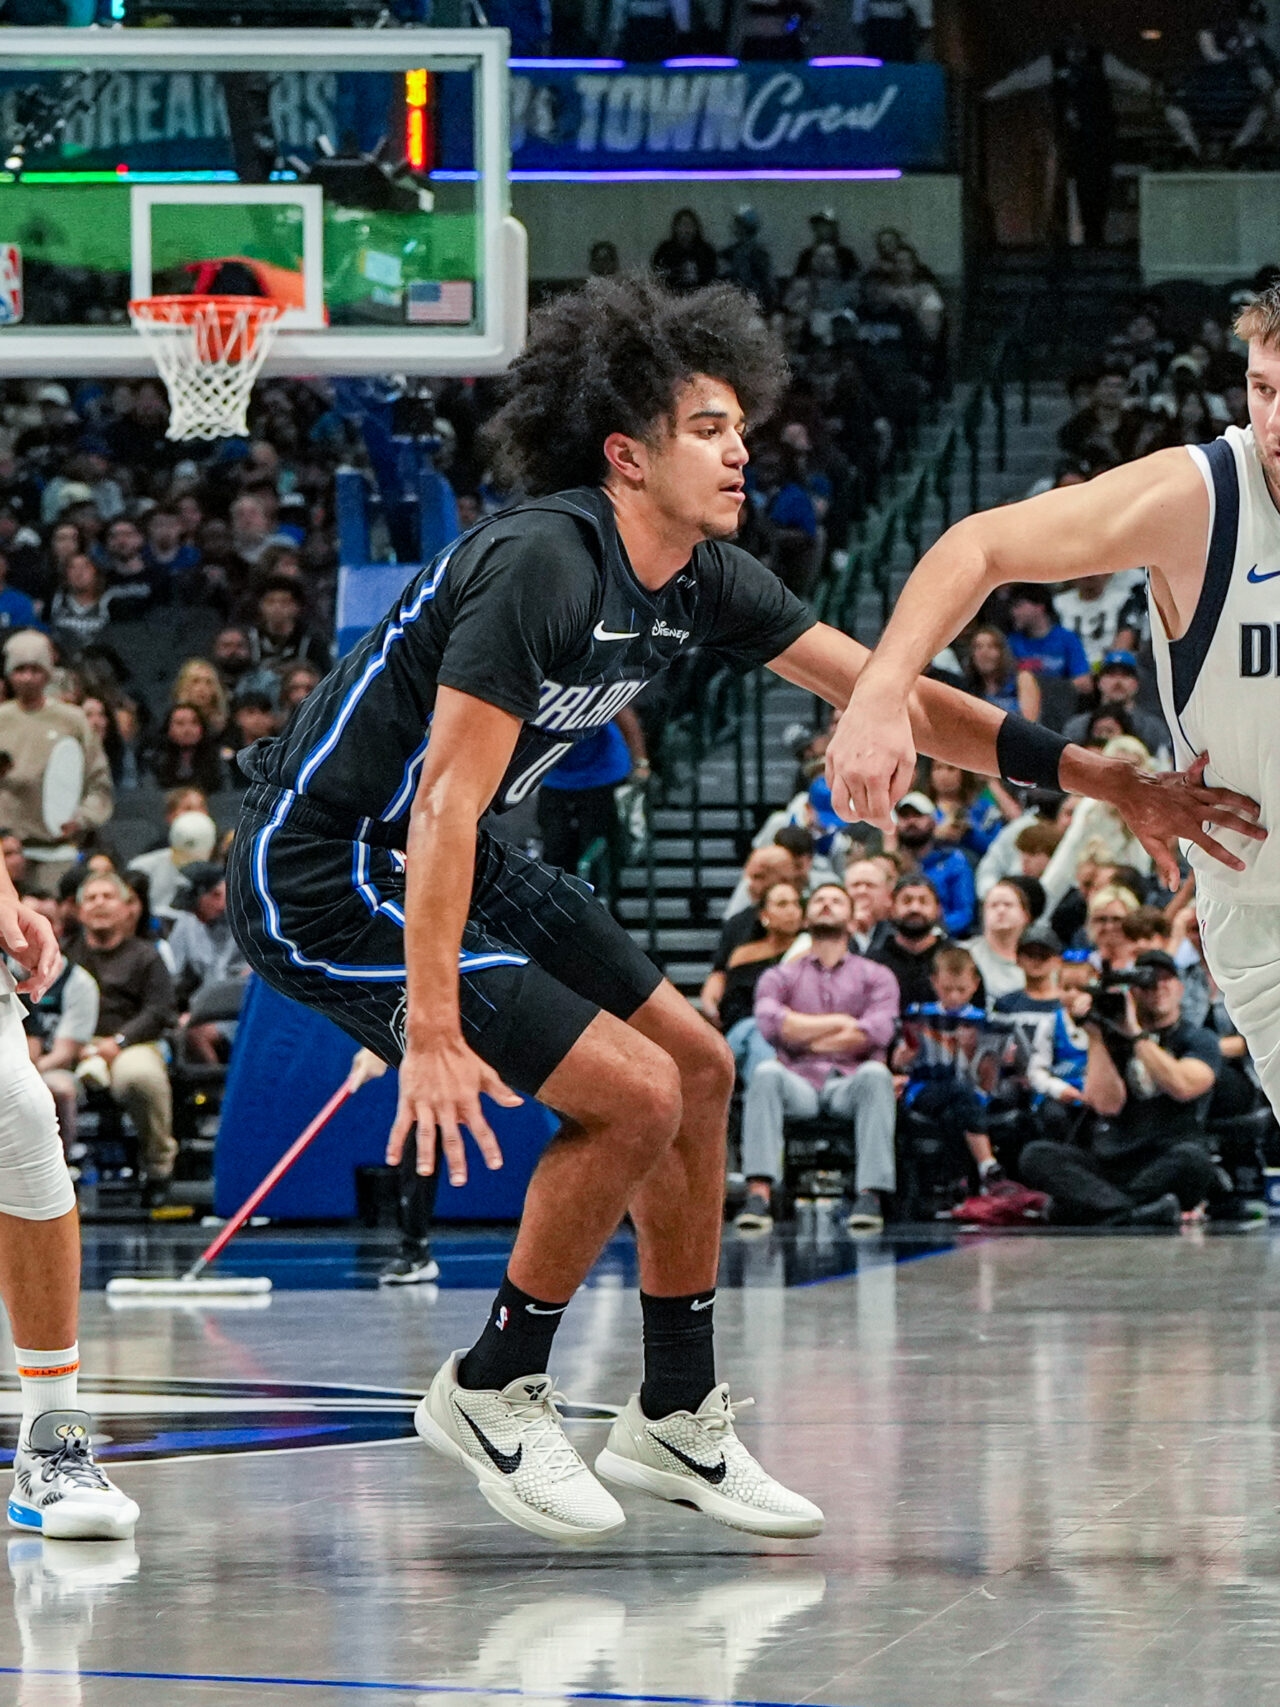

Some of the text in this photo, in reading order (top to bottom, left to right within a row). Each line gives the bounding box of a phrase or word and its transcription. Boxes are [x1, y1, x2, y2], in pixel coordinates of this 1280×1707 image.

[61, 72, 338, 150] BREAKRS
[574, 74, 748, 152] TOWN
[743, 73, 899, 150] Crew
